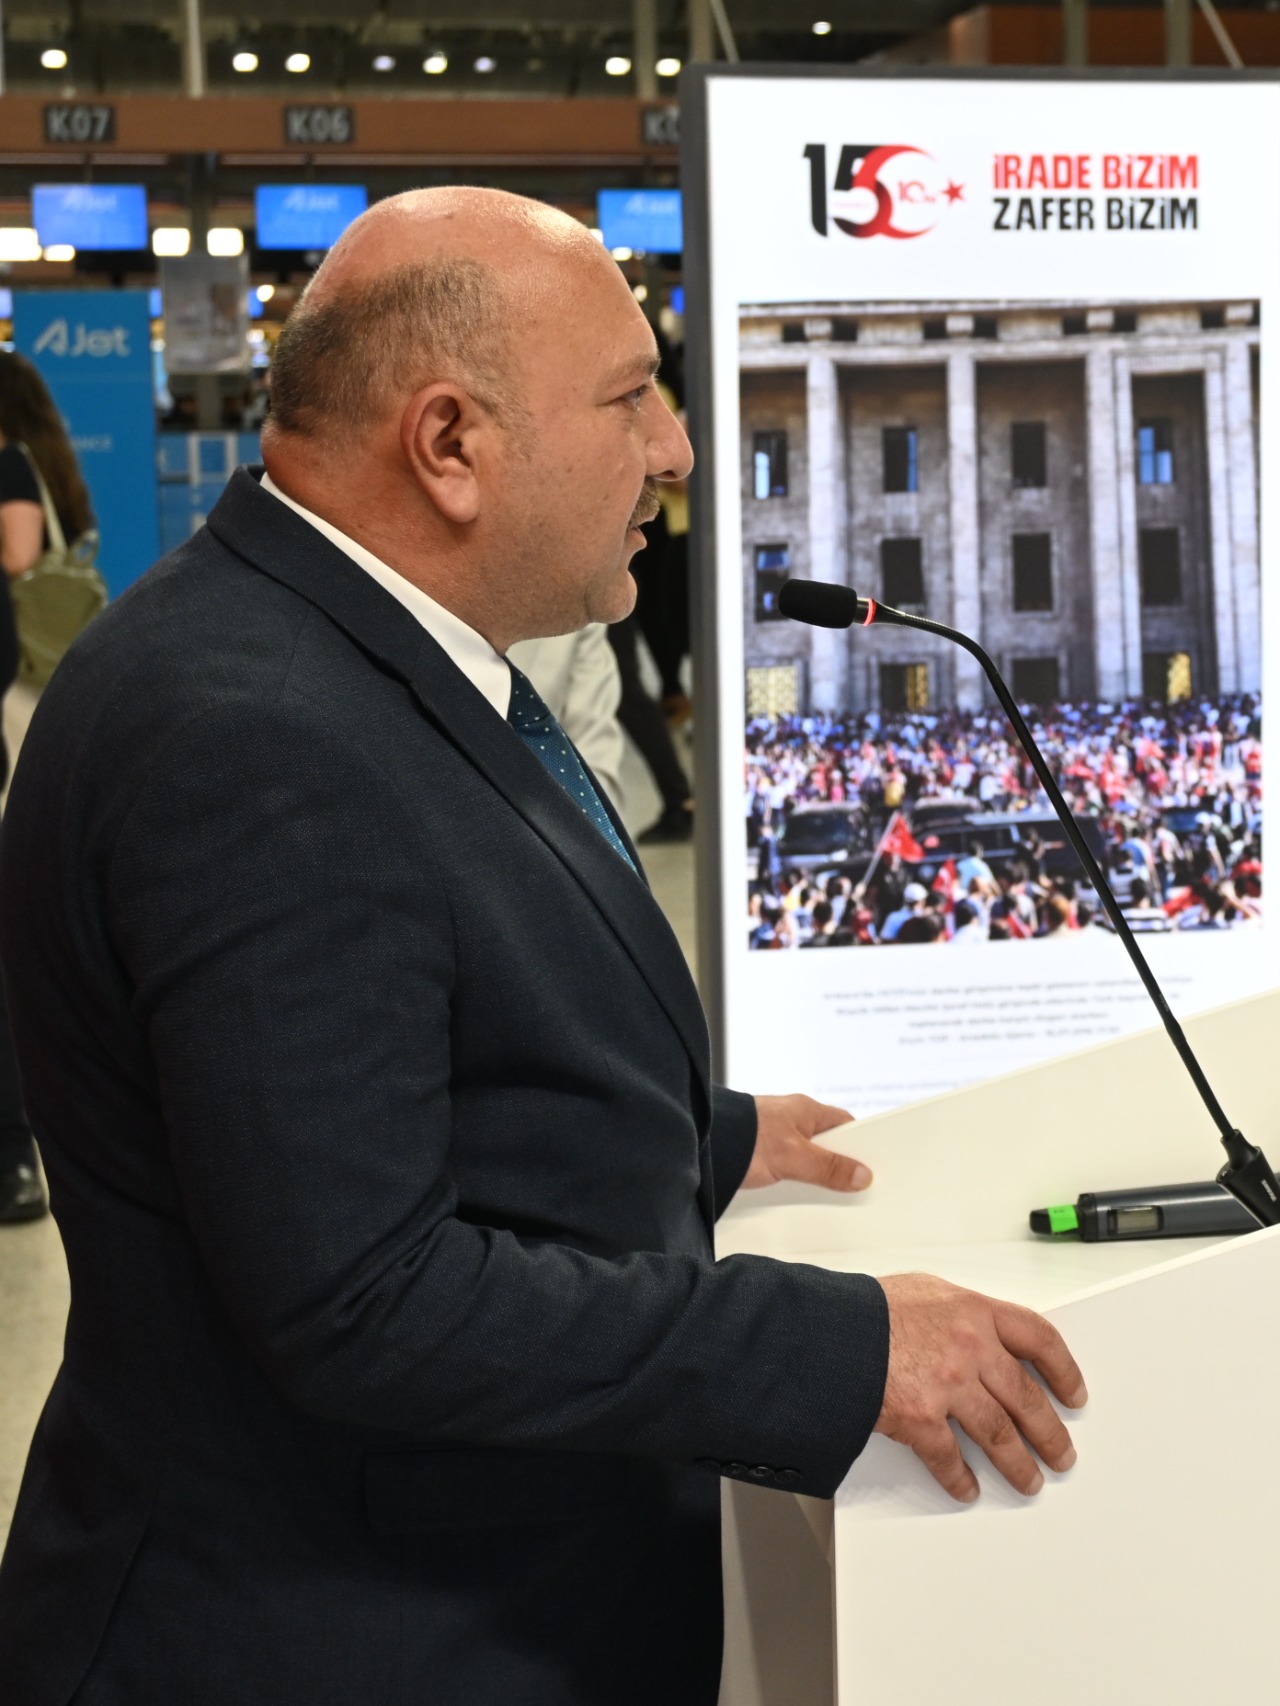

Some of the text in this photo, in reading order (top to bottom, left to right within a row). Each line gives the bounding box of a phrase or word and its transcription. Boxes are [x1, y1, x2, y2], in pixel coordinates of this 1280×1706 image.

[48, 105, 111, 141] K07
[288, 107, 350, 142] K06
[993, 197, 1095, 231] ZAFER
[33, 318, 129, 357] AJet
